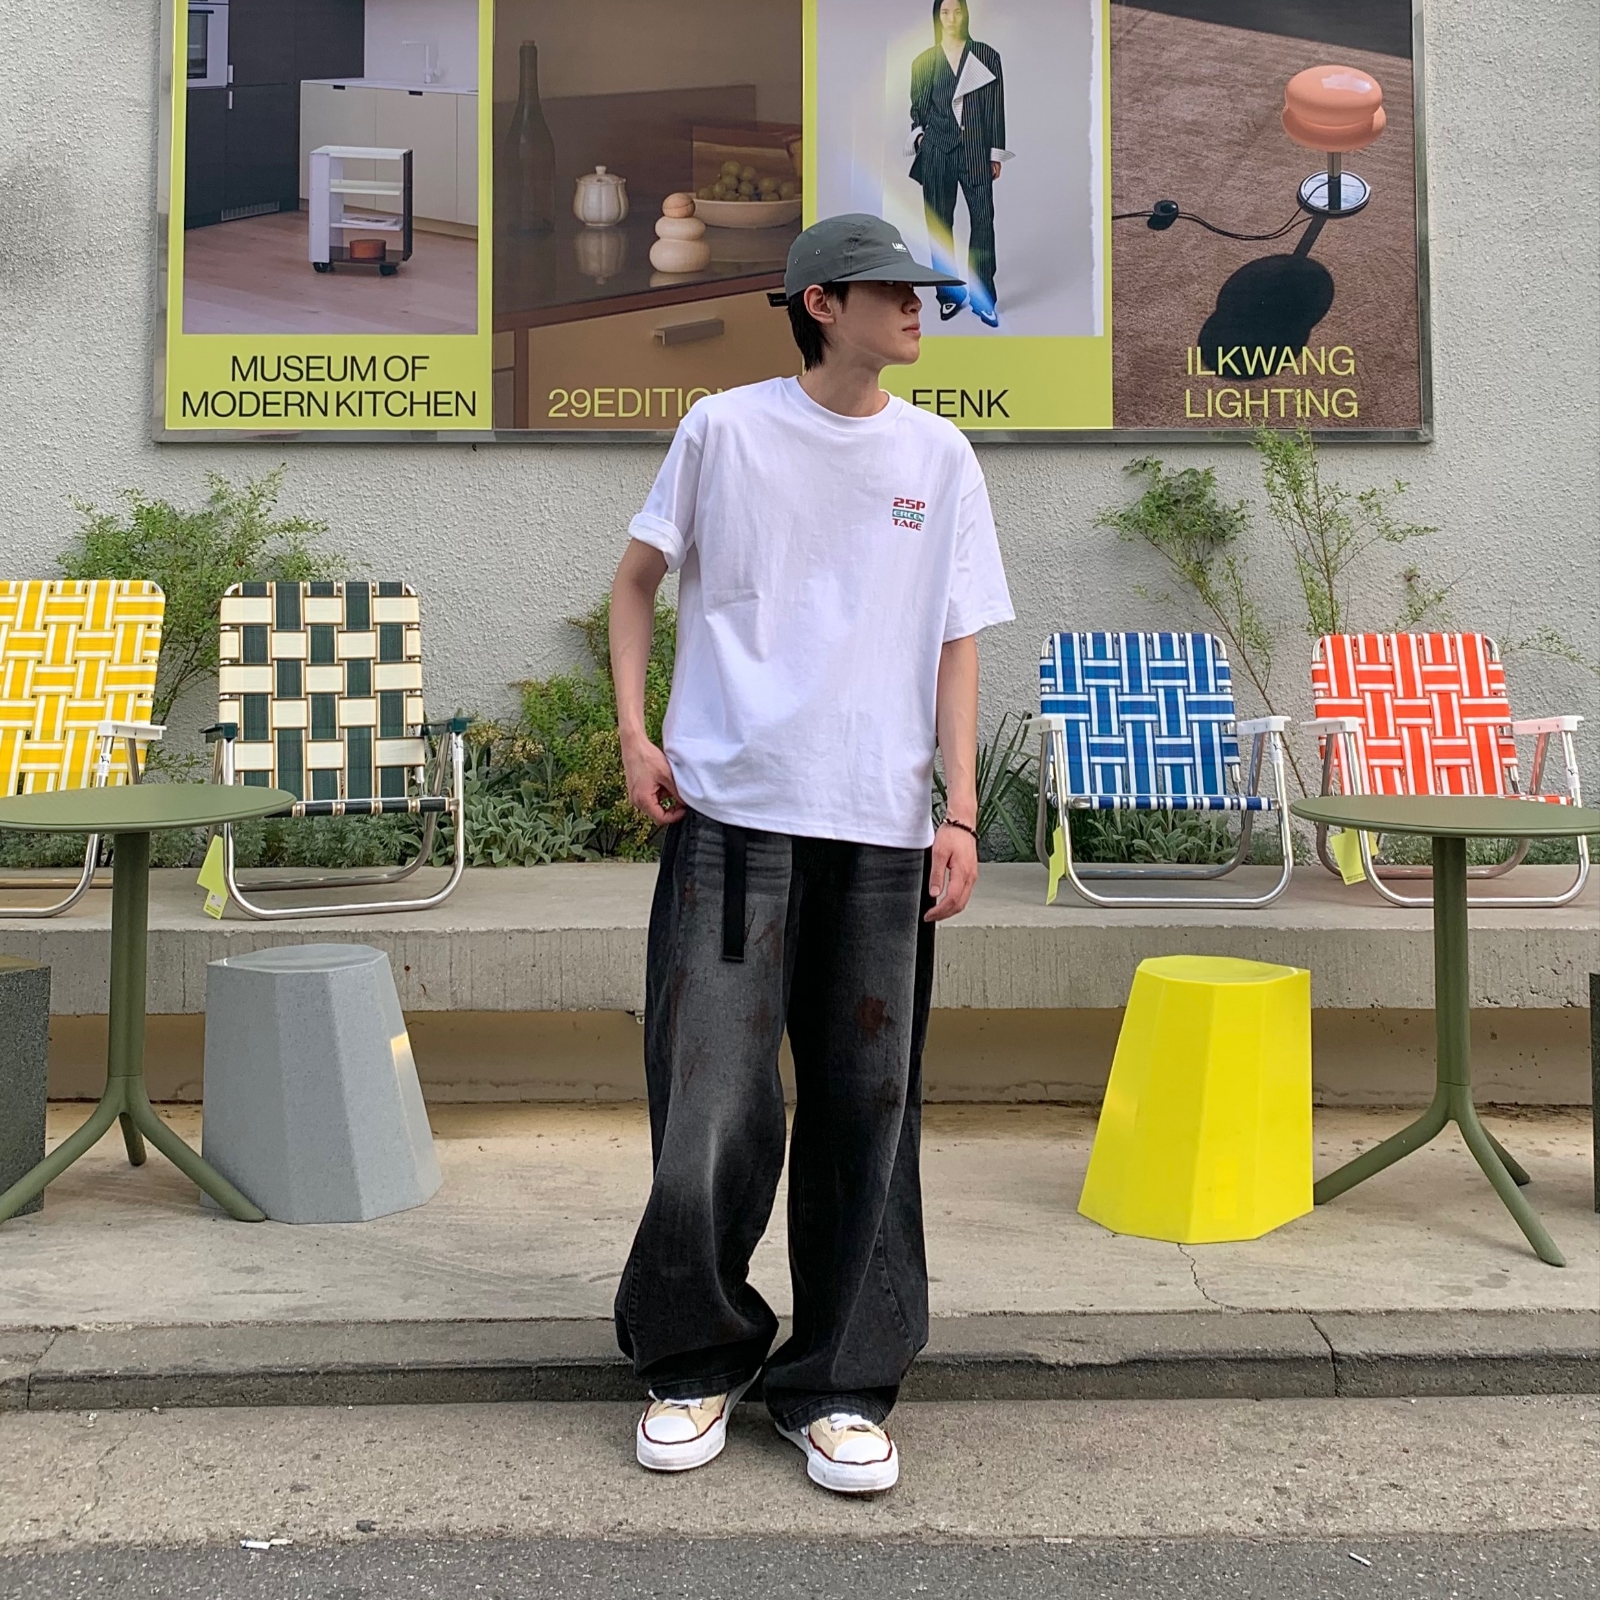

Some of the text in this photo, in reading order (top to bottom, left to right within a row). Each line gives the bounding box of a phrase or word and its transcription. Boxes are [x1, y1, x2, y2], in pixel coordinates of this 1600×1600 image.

[231, 355, 430, 382] MUSEUM OF
[1187, 346, 1355, 375] ILKWANG
[182, 391, 476, 417] MODERN KITCHEN
[548, 388, 725, 418] 29EDITIO
[1185, 388, 1359, 418] LIGHTING
[893, 497, 926, 511] 25P
[892, 518, 923, 531] TAGE
